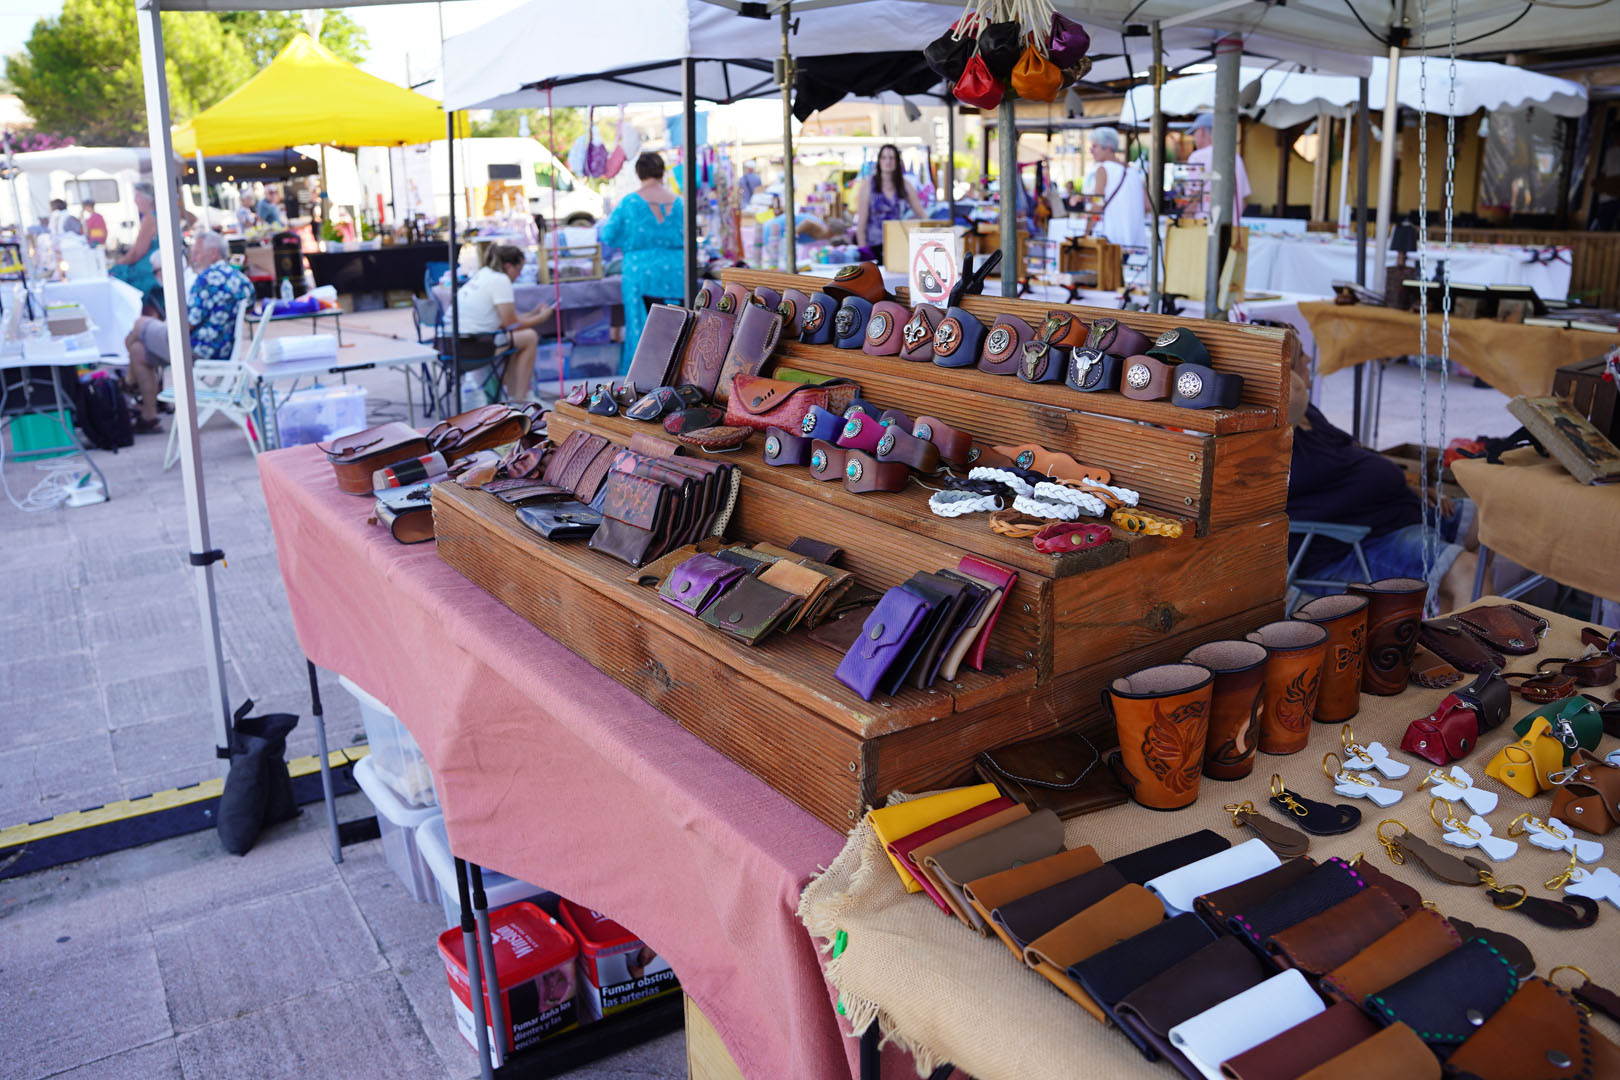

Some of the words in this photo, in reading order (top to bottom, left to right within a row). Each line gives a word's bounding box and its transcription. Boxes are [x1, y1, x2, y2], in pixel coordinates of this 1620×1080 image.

[496, 925, 534, 959] Winston
[602, 981, 635, 997] Fumar
[603, 997, 619, 1008] las
[621, 986, 660, 1003] arterias
[513, 1017, 538, 1033] Fumar
